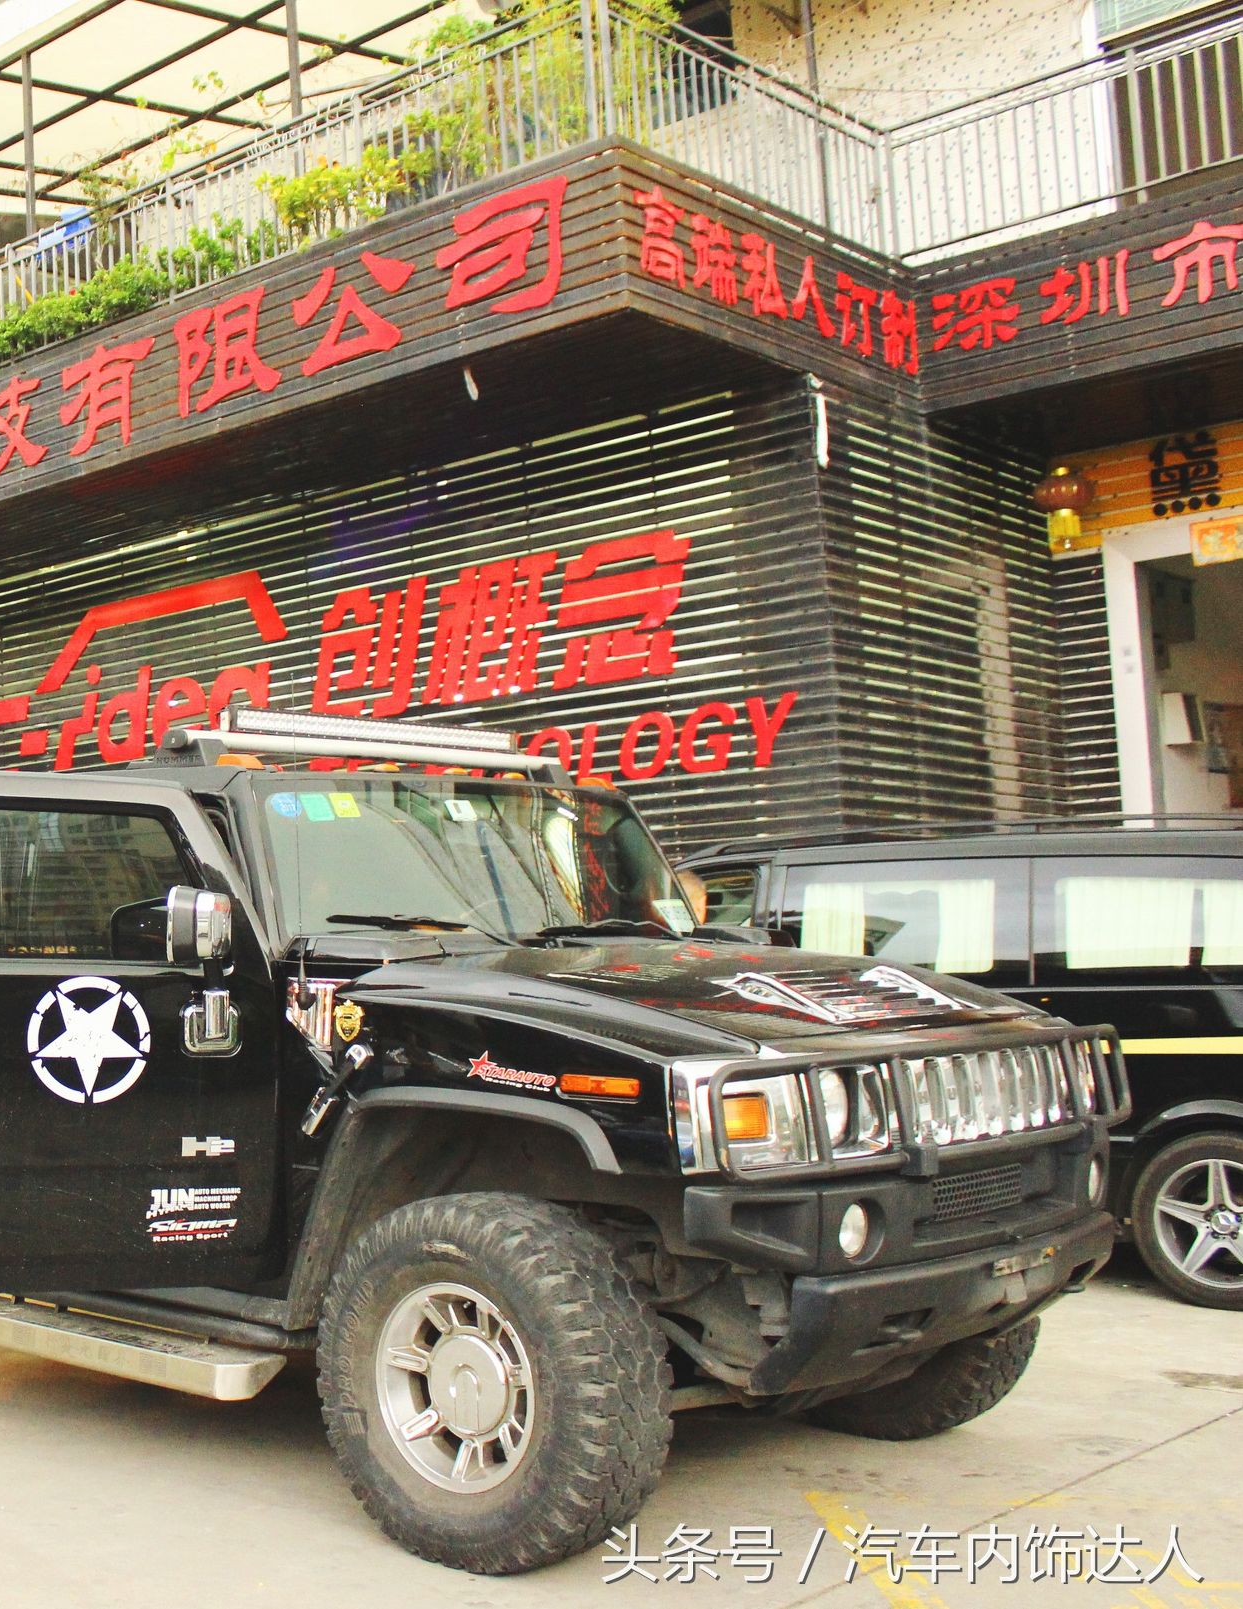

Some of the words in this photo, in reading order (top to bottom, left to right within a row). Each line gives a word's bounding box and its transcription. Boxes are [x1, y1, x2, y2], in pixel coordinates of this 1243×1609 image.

[633, 184, 919, 376] 高端私人订制
[931, 221, 1243, 351] 深圳市
[181, 1136, 235, 1156] H2
[151, 1188, 195, 1211] JUN
[152, 1233, 194, 1242] Racing
[196, 1232, 228, 1240] Sport
